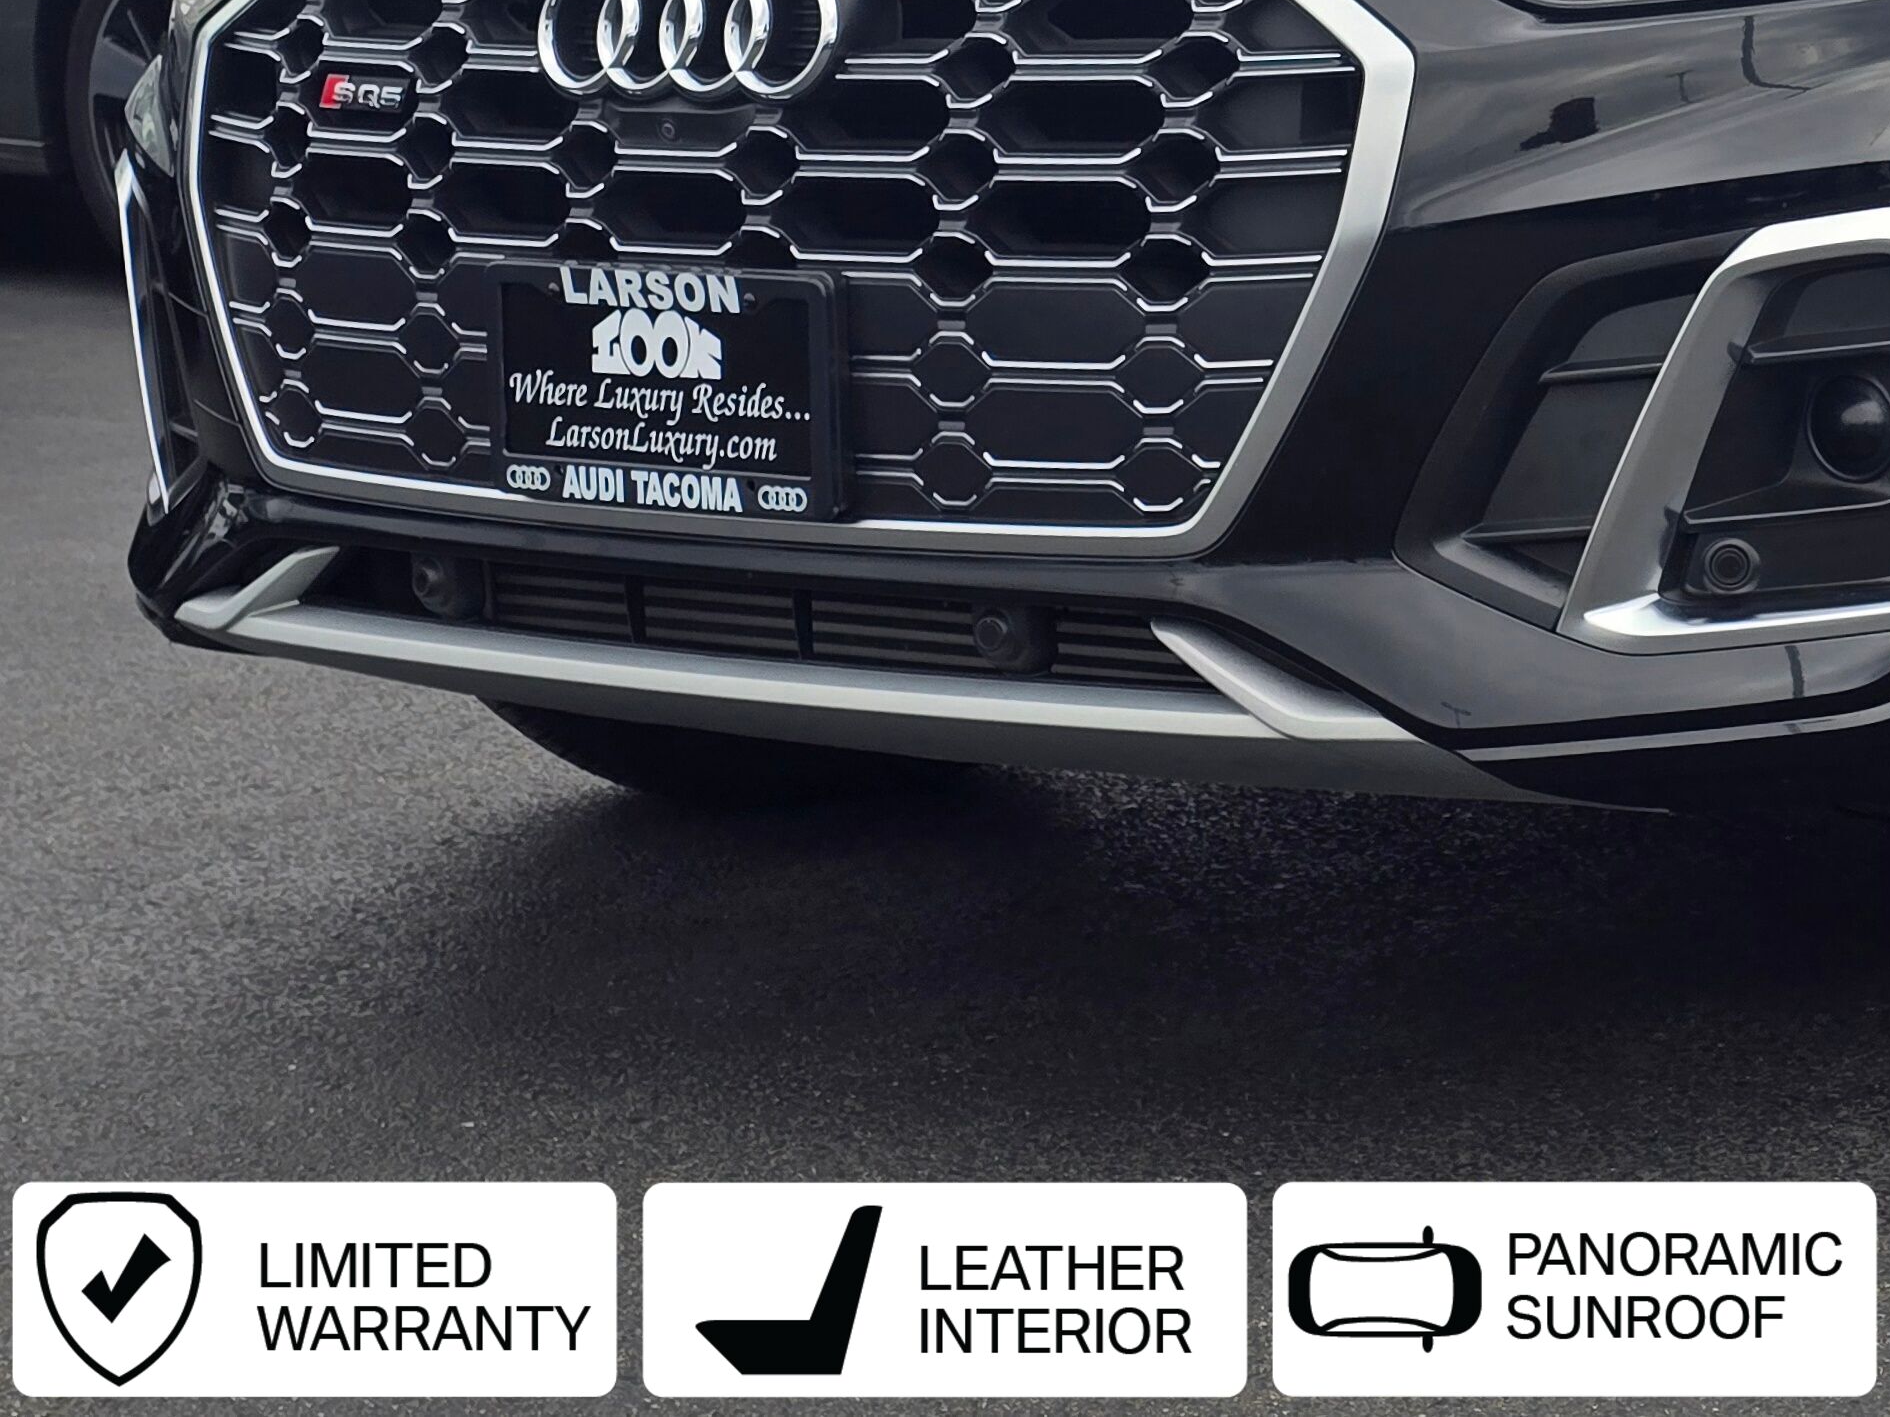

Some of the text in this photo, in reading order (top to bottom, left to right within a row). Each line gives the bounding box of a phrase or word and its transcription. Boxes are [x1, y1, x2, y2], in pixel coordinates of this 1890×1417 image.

[332, 81, 403, 109] SQ5
[560, 266, 741, 314] LARSON
[509, 370, 812, 426] Where Luxury Resides...
[545, 416, 778, 471] LarsonLuxury.com
[562, 465, 744, 513] AUDI TACOMA
